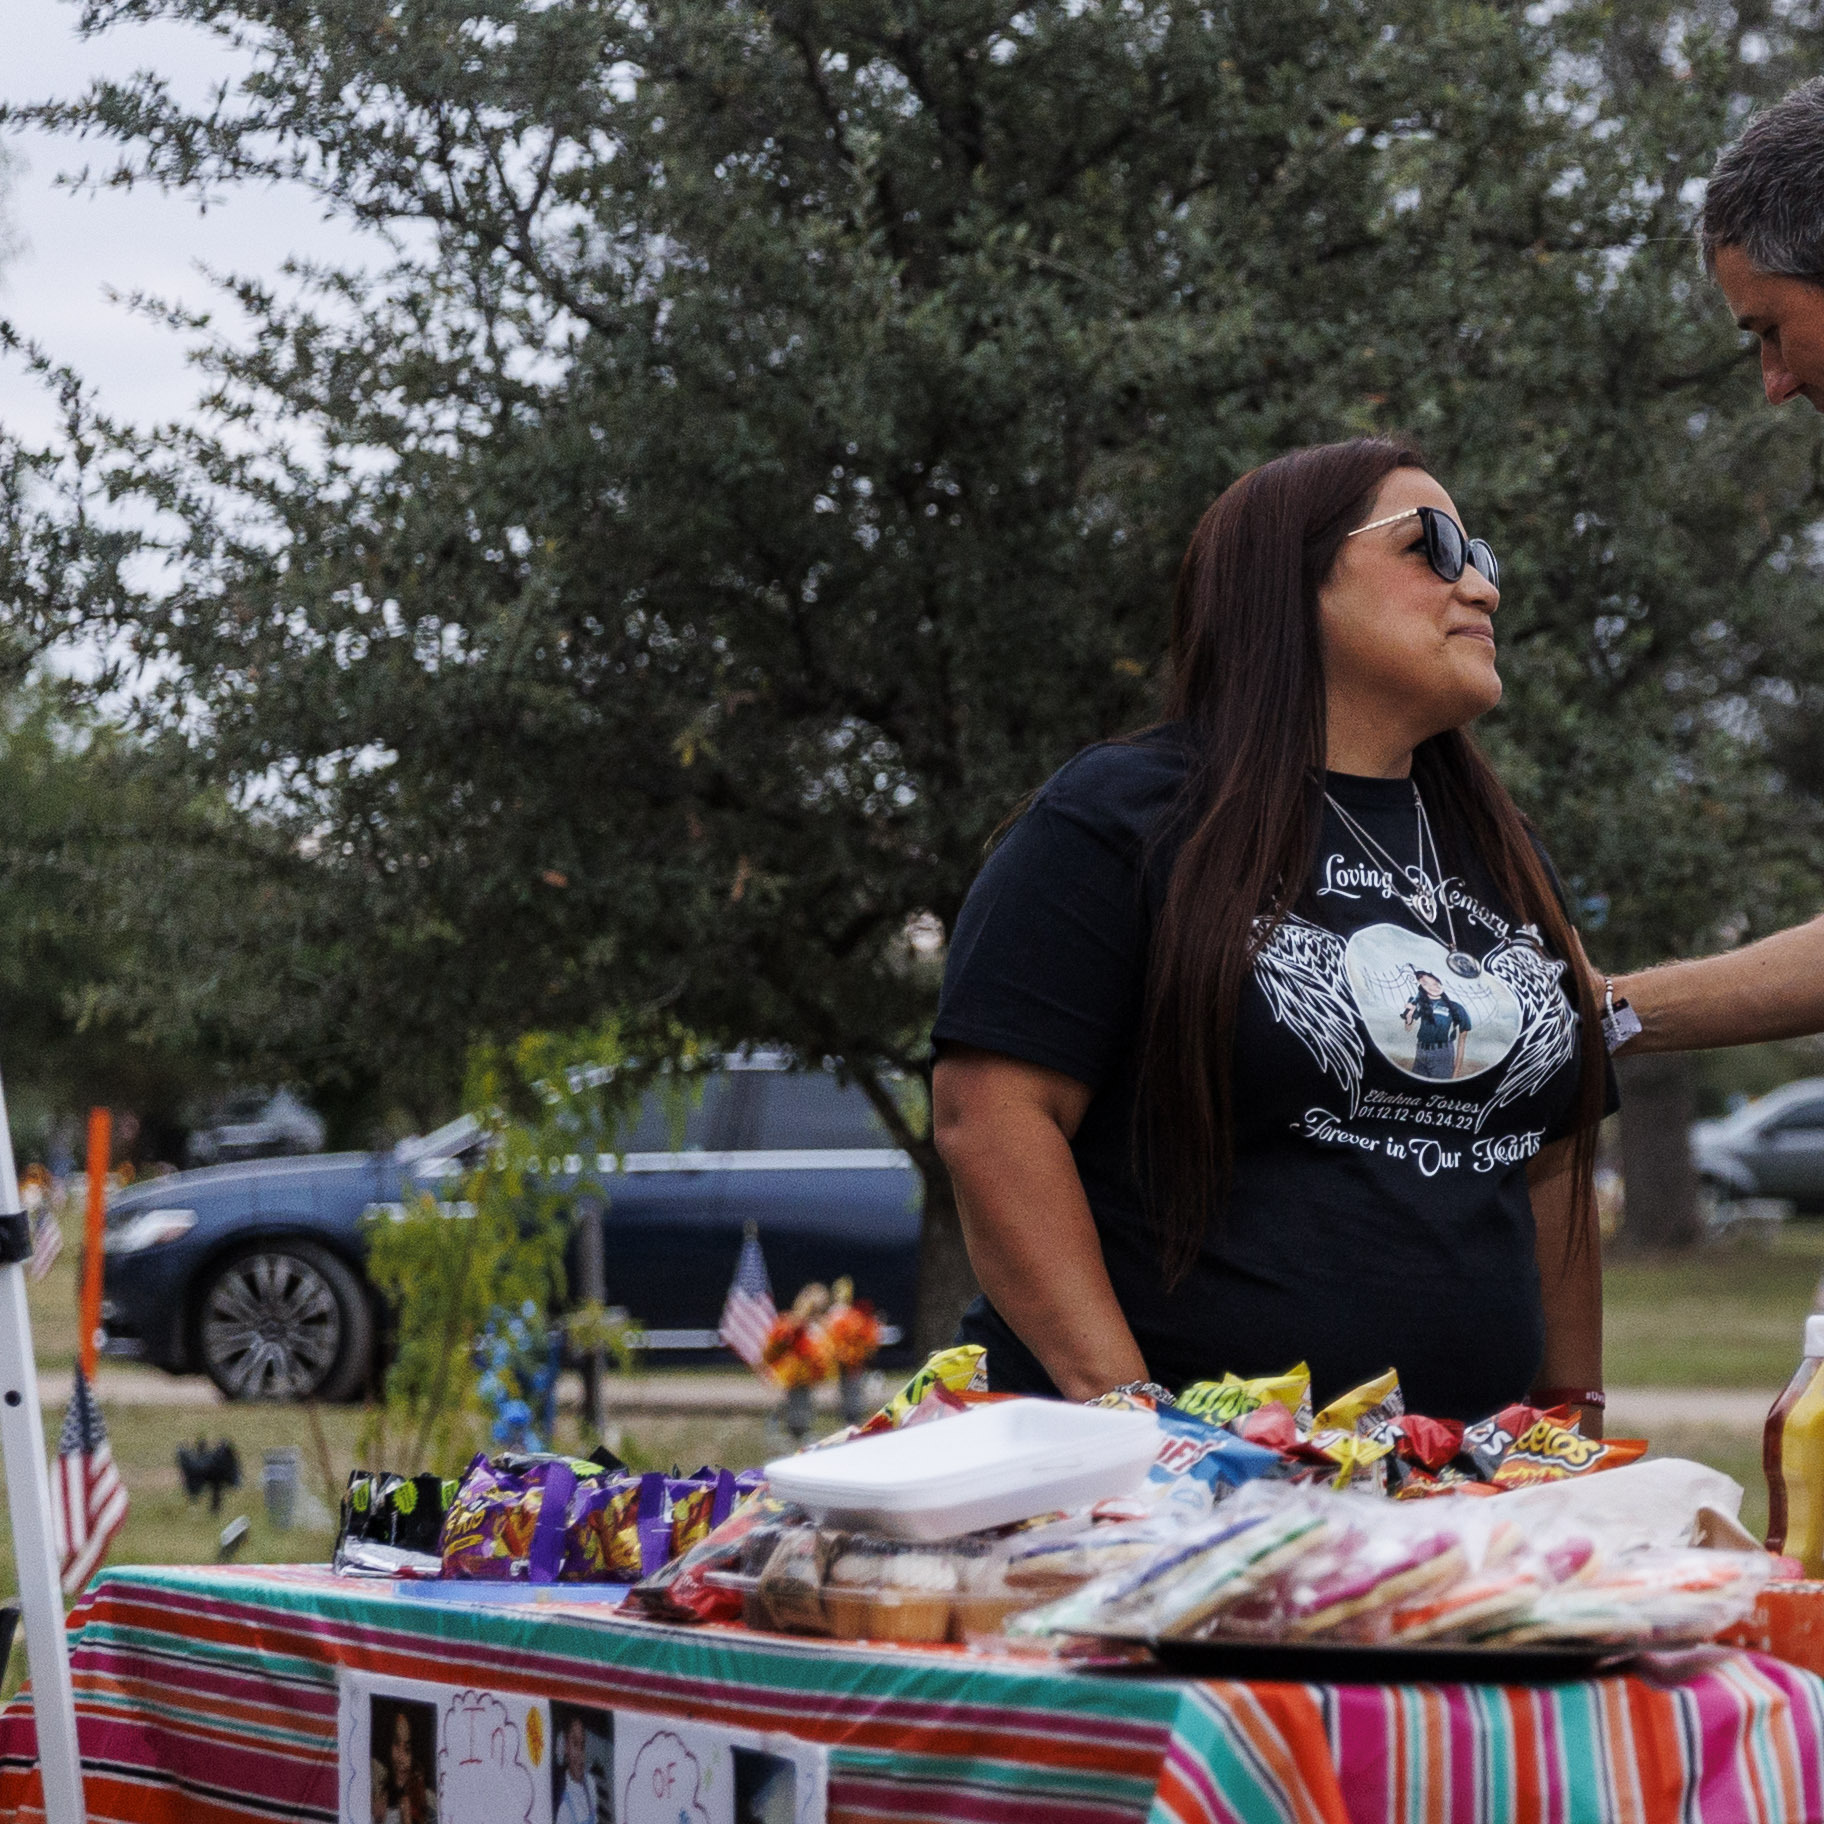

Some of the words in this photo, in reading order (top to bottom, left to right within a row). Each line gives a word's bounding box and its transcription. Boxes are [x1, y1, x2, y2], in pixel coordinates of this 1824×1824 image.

[1316, 853, 1402, 900] Loving
[1405, 865, 1510, 938] Memory
[1363, 1088, 1422, 1106] Eliahna
[1424, 1093, 1482, 1114] Torres
[1290, 1107, 1381, 1151] Forever
[1386, 1136, 1407, 1159] in
[1408, 1138, 1462, 1176] Our
[1472, 1127, 1546, 1172] Hearts
[458, 1705, 506, 1770] In
